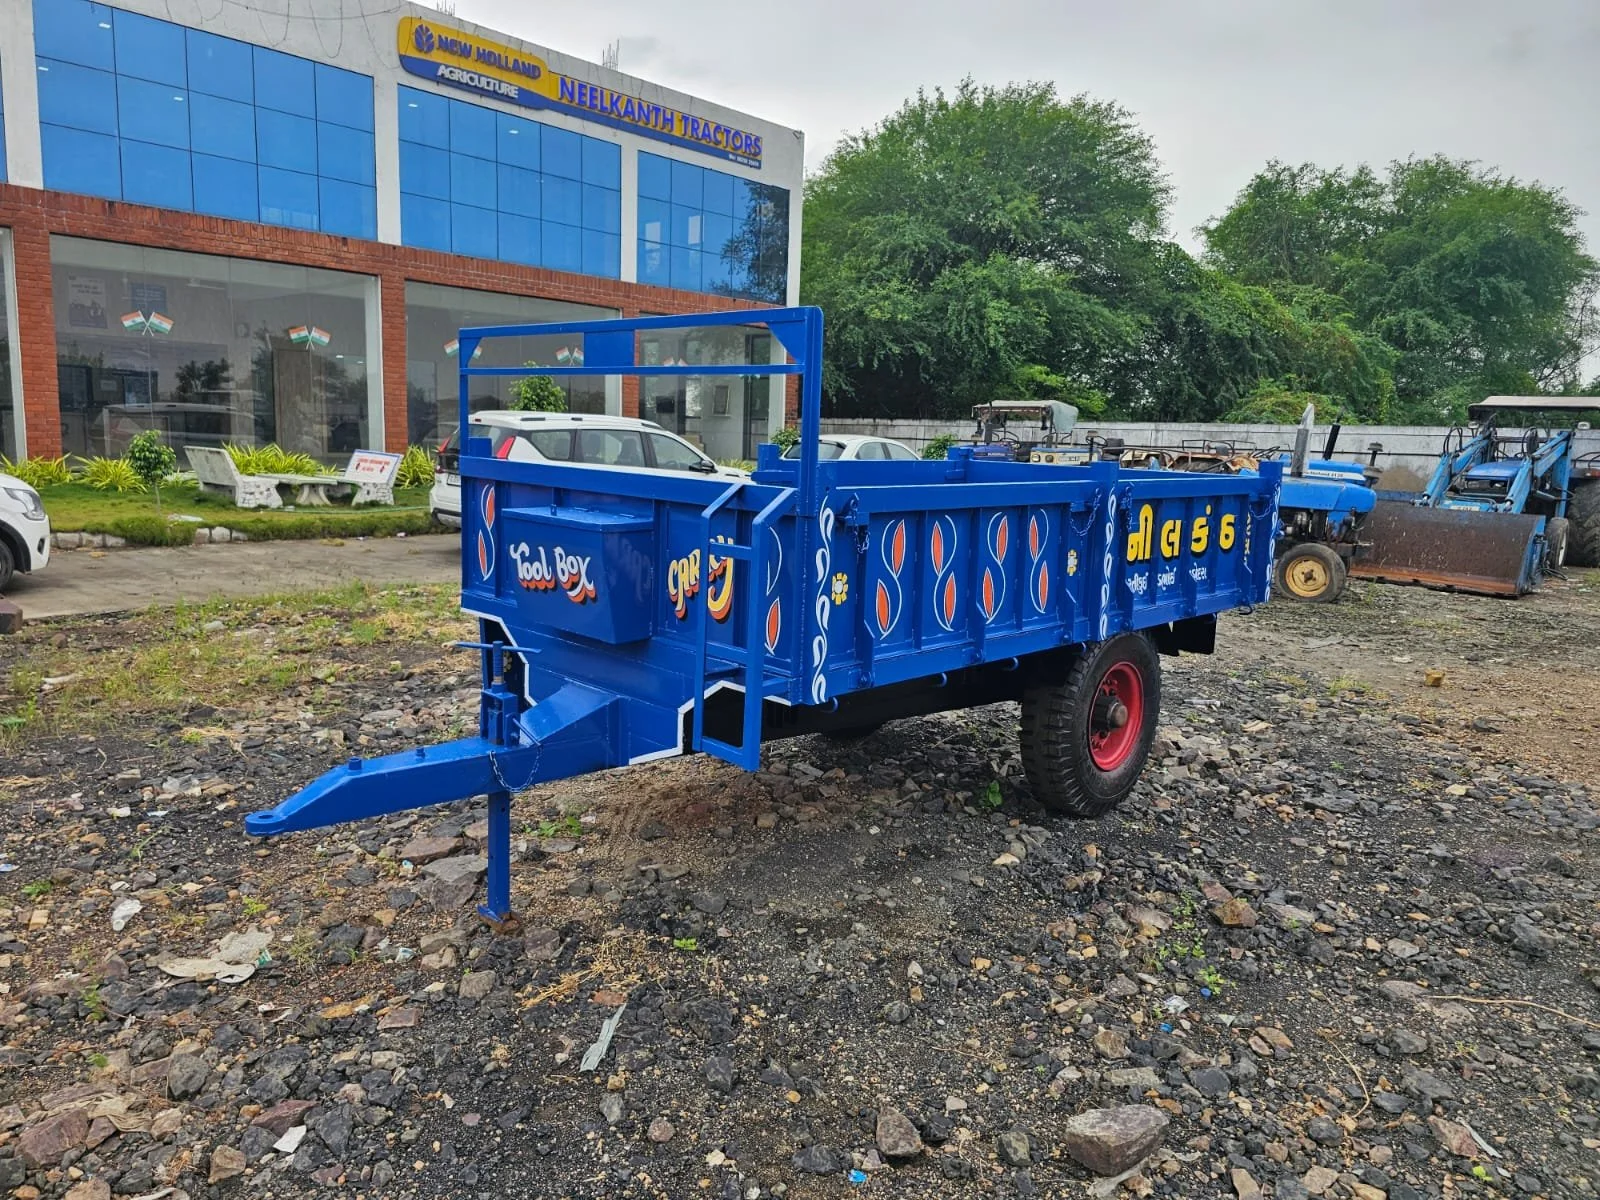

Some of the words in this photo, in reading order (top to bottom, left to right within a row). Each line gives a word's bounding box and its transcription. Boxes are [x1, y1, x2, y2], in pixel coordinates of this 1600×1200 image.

[437, 34, 473, 61] NEW
[475, 49, 542, 80] HOLLAND
[436, 65, 519, 98] AGRICULTURE
[558, 77, 675, 134] NEELKANTH
[681, 114, 763, 157] TRACTORS
[509, 541, 554, 588] Tool
